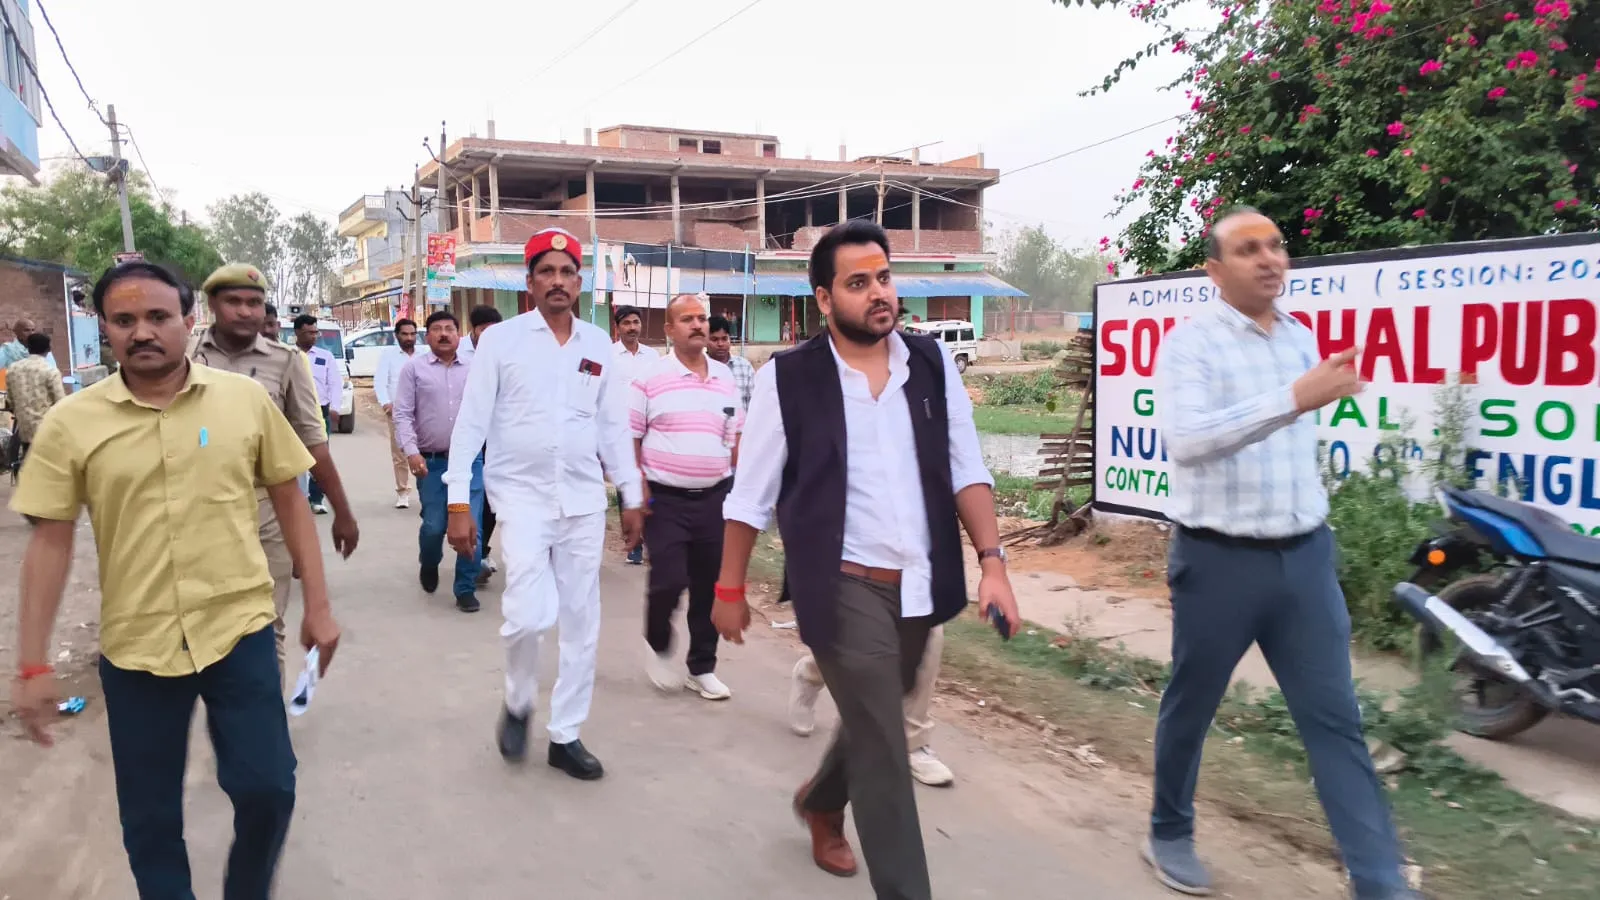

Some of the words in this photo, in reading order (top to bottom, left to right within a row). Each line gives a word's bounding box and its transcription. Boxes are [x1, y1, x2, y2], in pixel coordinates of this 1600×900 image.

[1128, 286, 1217, 307] ADMISSI
[1547, 258, 1600, 282] 20
[1459, 298, 1600, 386] PUB
[1480, 398, 1600, 442] SO
[1105, 465, 1169, 497] CONTA
